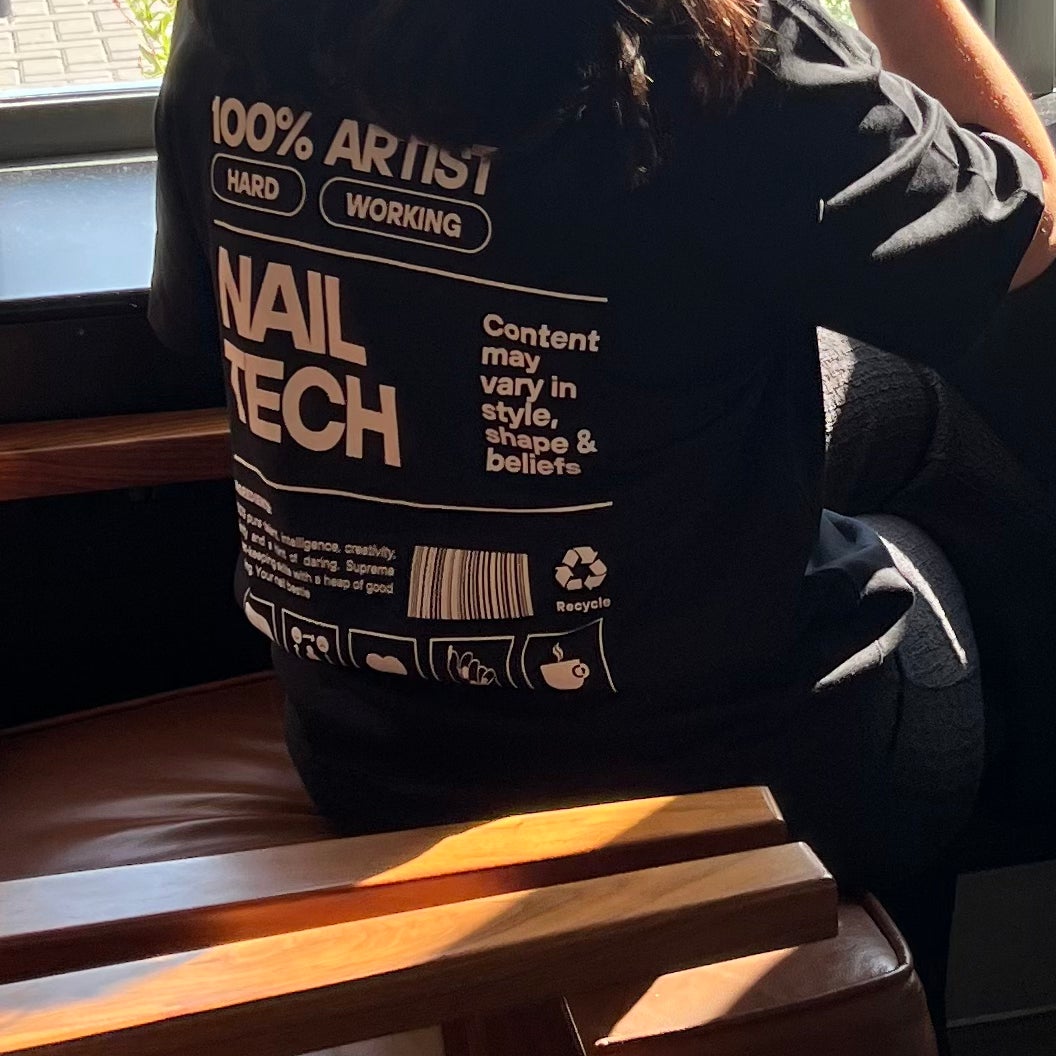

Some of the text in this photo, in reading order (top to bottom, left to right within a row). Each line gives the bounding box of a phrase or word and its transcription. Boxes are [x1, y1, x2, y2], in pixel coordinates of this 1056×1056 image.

[212, 96, 498, 196] 100% ARTIST
[227, 168, 280, 201] HARD
[345, 192, 462, 238] WORKING
[218, 246, 367, 367] NAIL
[483, 313, 600, 353] Content
[481, 346, 541, 374] may
[224, 338, 401, 468] TECH
[480, 375, 577, 403] vary in
[481, 396, 559, 430] style,
[485, 426, 598, 455] shape &
[486, 447, 582, 476] beliefs
[346, 559, 395, 577] Supreme
[365, 582, 394, 595] good
[556, 596, 612, 613] Recycle
